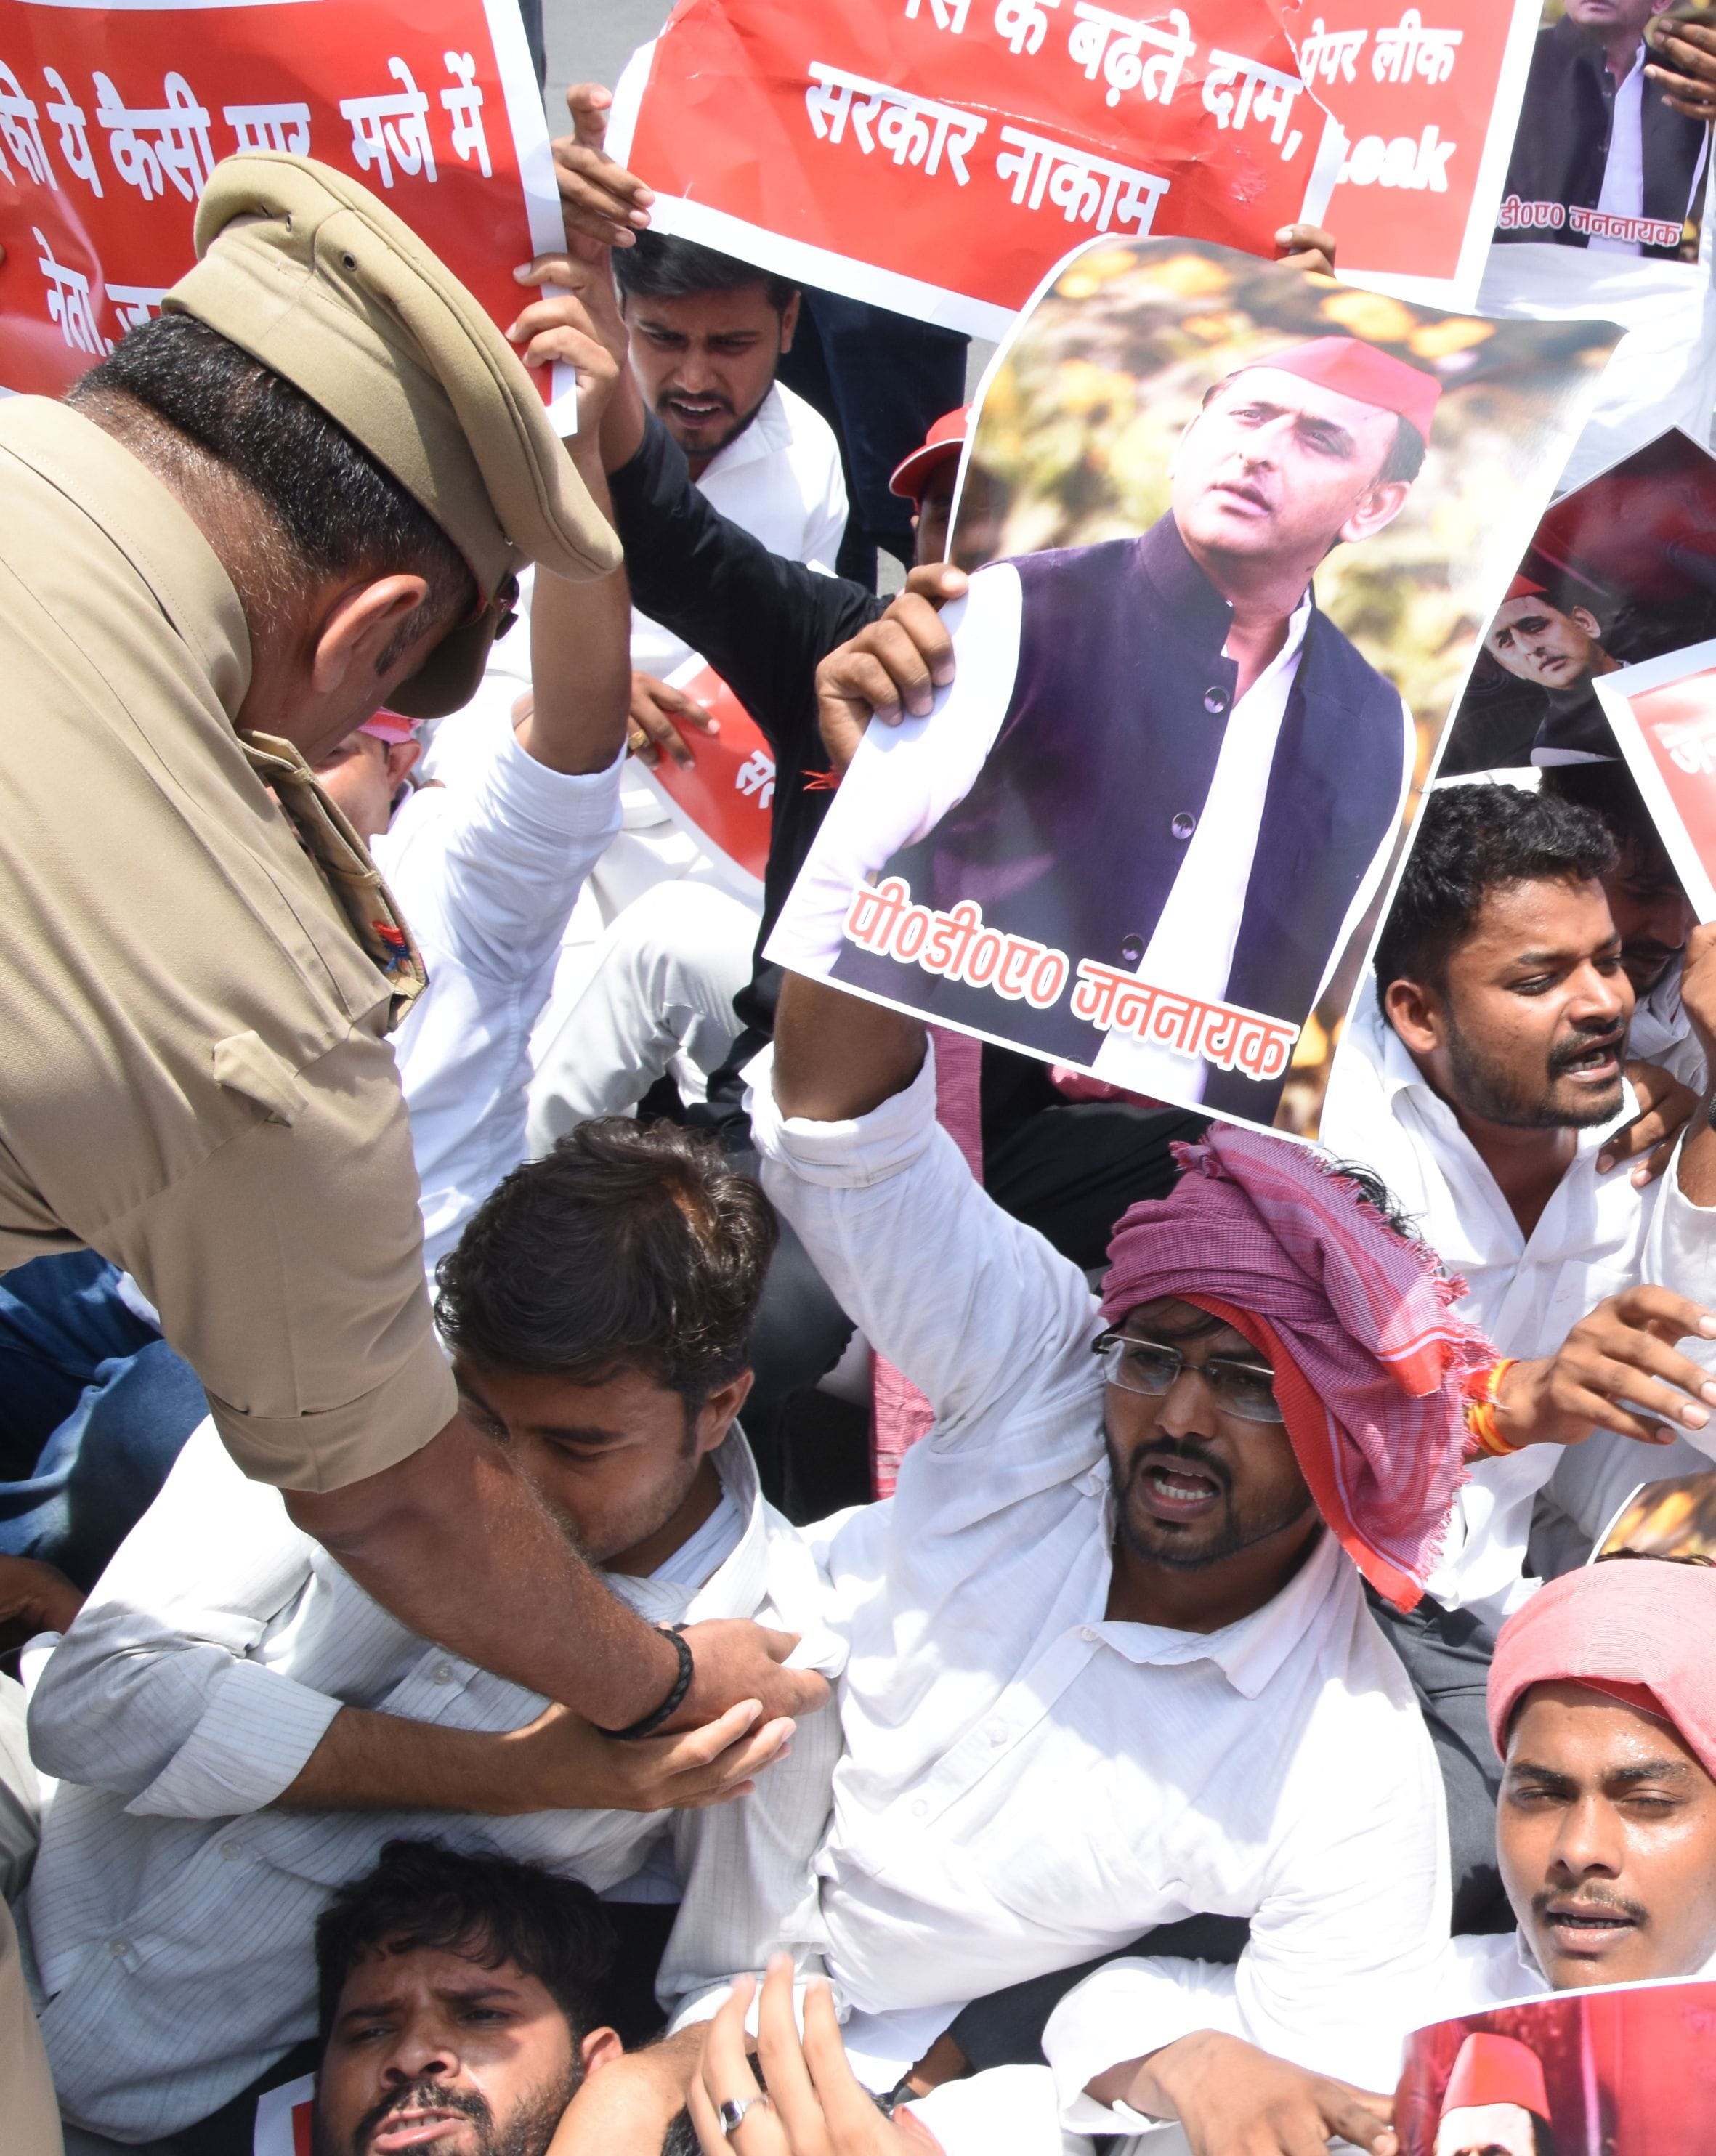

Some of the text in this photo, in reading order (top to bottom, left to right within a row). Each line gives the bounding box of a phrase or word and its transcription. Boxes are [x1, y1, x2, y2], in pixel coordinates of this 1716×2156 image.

[1068, 1, 1197, 107] बढ़ते
[1202, 49, 1303, 161] दाम,
[1300, 8, 1463, 88] पेपर लीक
[43, 66, 104, 198] ये
[92, 70, 216, 203] कैसी
[339, 56, 437, 189] मजे
[440, 51, 493, 178] में
[805, 60, 1170, 237] सरकार नाकाम
[1335, 124, 1457, 192] eak
[1569, 206, 1682, 246] जननायक
[1073, 962, 1298, 1077] जननायक
